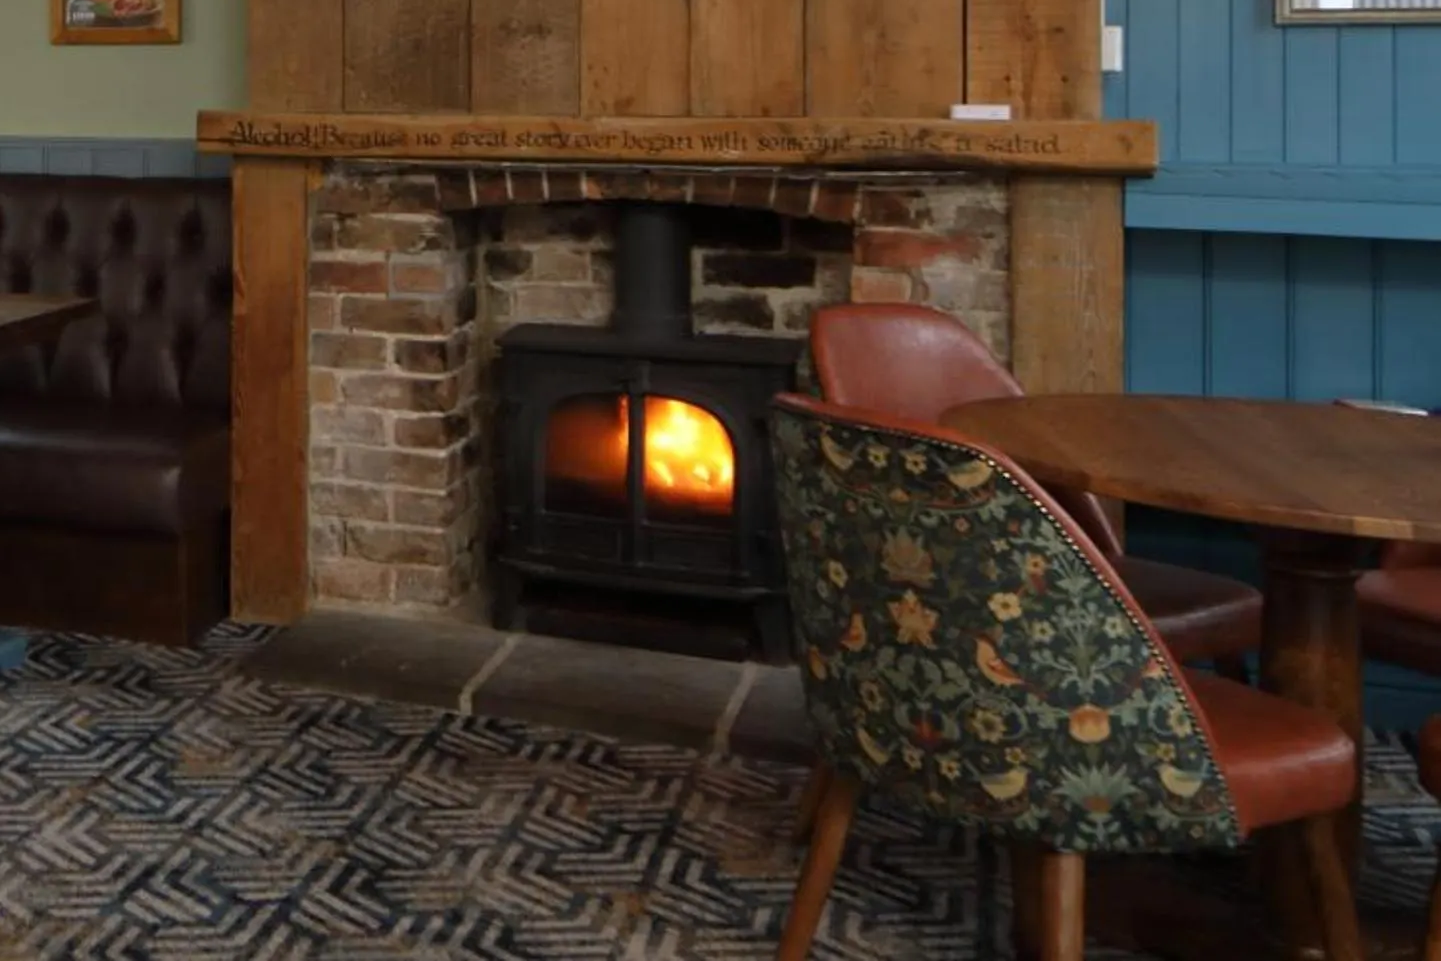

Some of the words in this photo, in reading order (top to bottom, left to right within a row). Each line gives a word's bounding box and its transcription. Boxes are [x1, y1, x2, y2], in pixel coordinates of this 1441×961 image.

[416, 132, 441, 146] no
[451, 129, 508, 149] great
[622, 130, 694, 152] began
[700, 131, 748, 151] with
[955, 137, 972, 151] a
